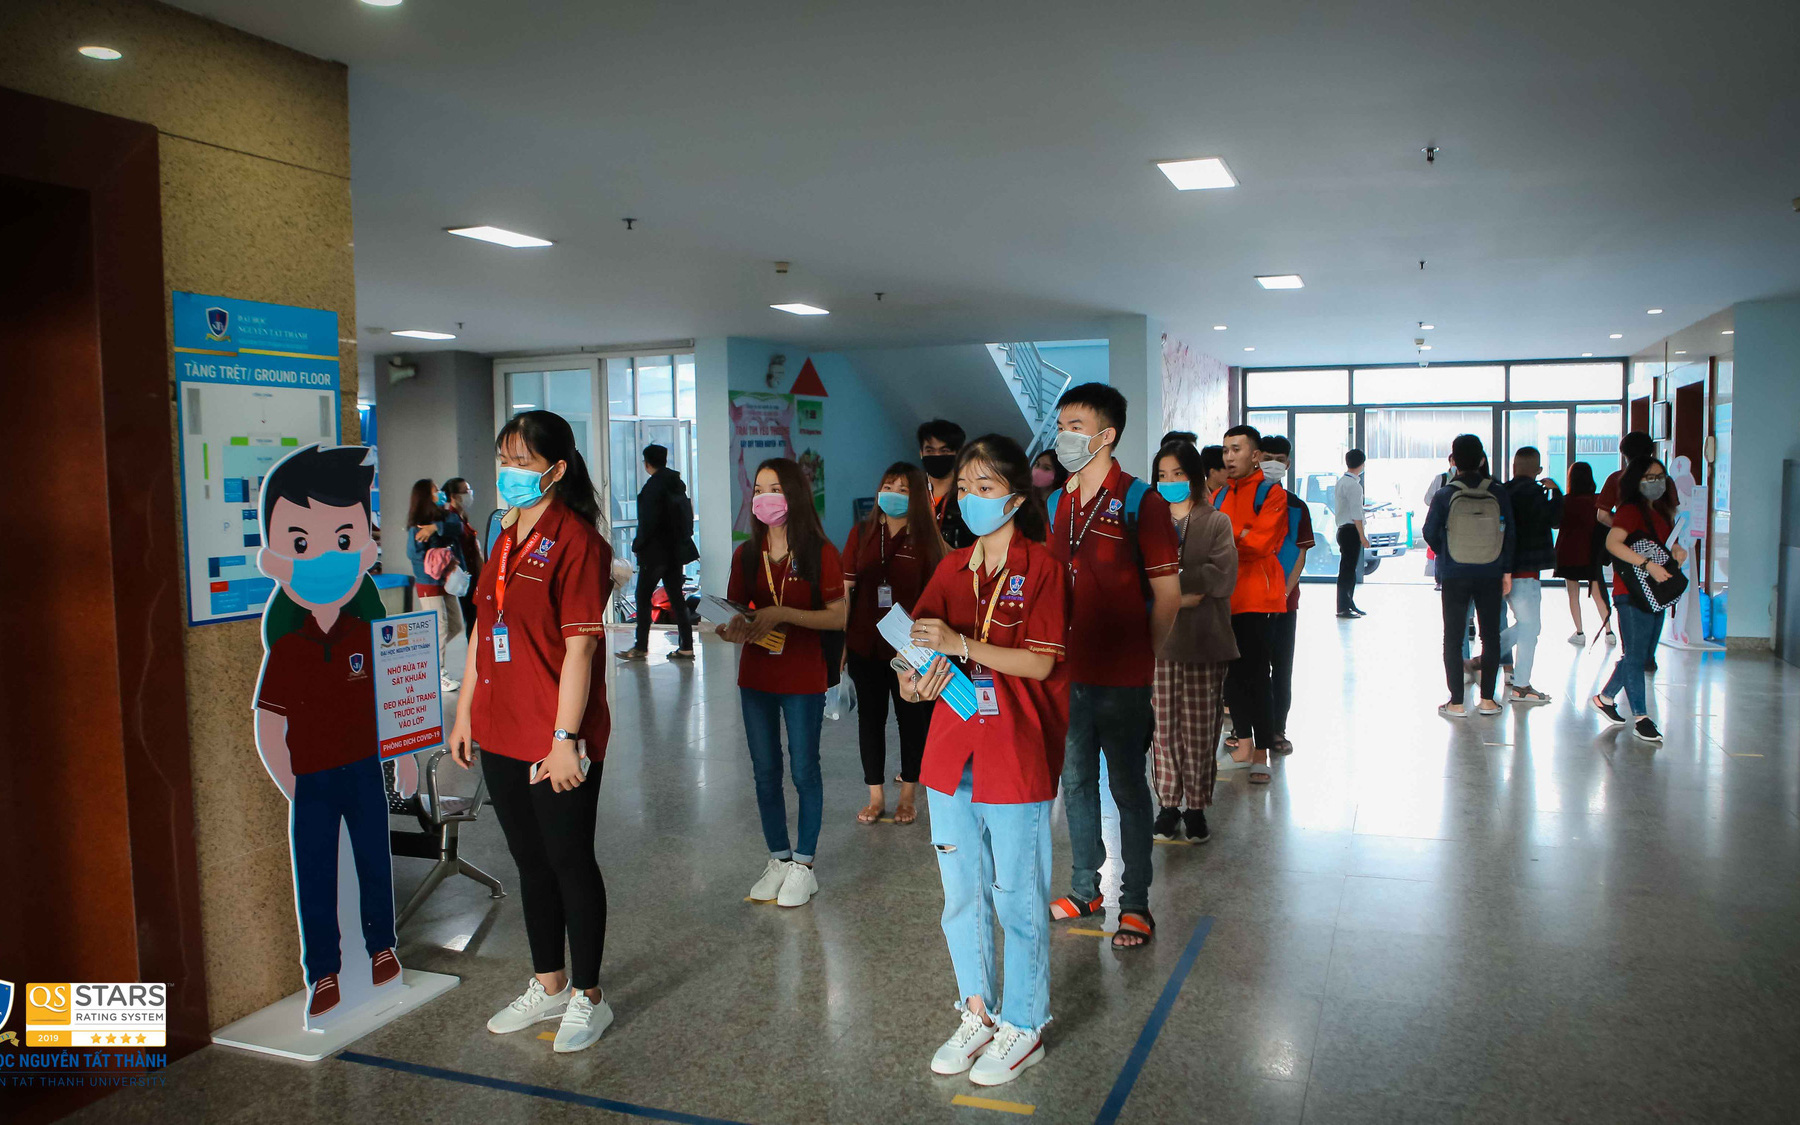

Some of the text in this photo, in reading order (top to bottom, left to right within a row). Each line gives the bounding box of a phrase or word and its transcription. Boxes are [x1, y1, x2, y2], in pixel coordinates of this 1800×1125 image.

[254, 367, 297, 384] GROUND
[300, 371, 331, 385] FLOOR
[408, 621, 429, 632] STARS
[417, 660, 428, 669] TAY
[405, 684, 414, 694] VÀ
[383, 701, 396, 710] ĐEO
[416, 692, 437, 703] TRANG
[416, 705, 427, 714] KHI
[398, 719, 411, 729] VÀO
[382, 740, 403, 752] PHÒNG
[416, 730, 440, 743] COVID-19
